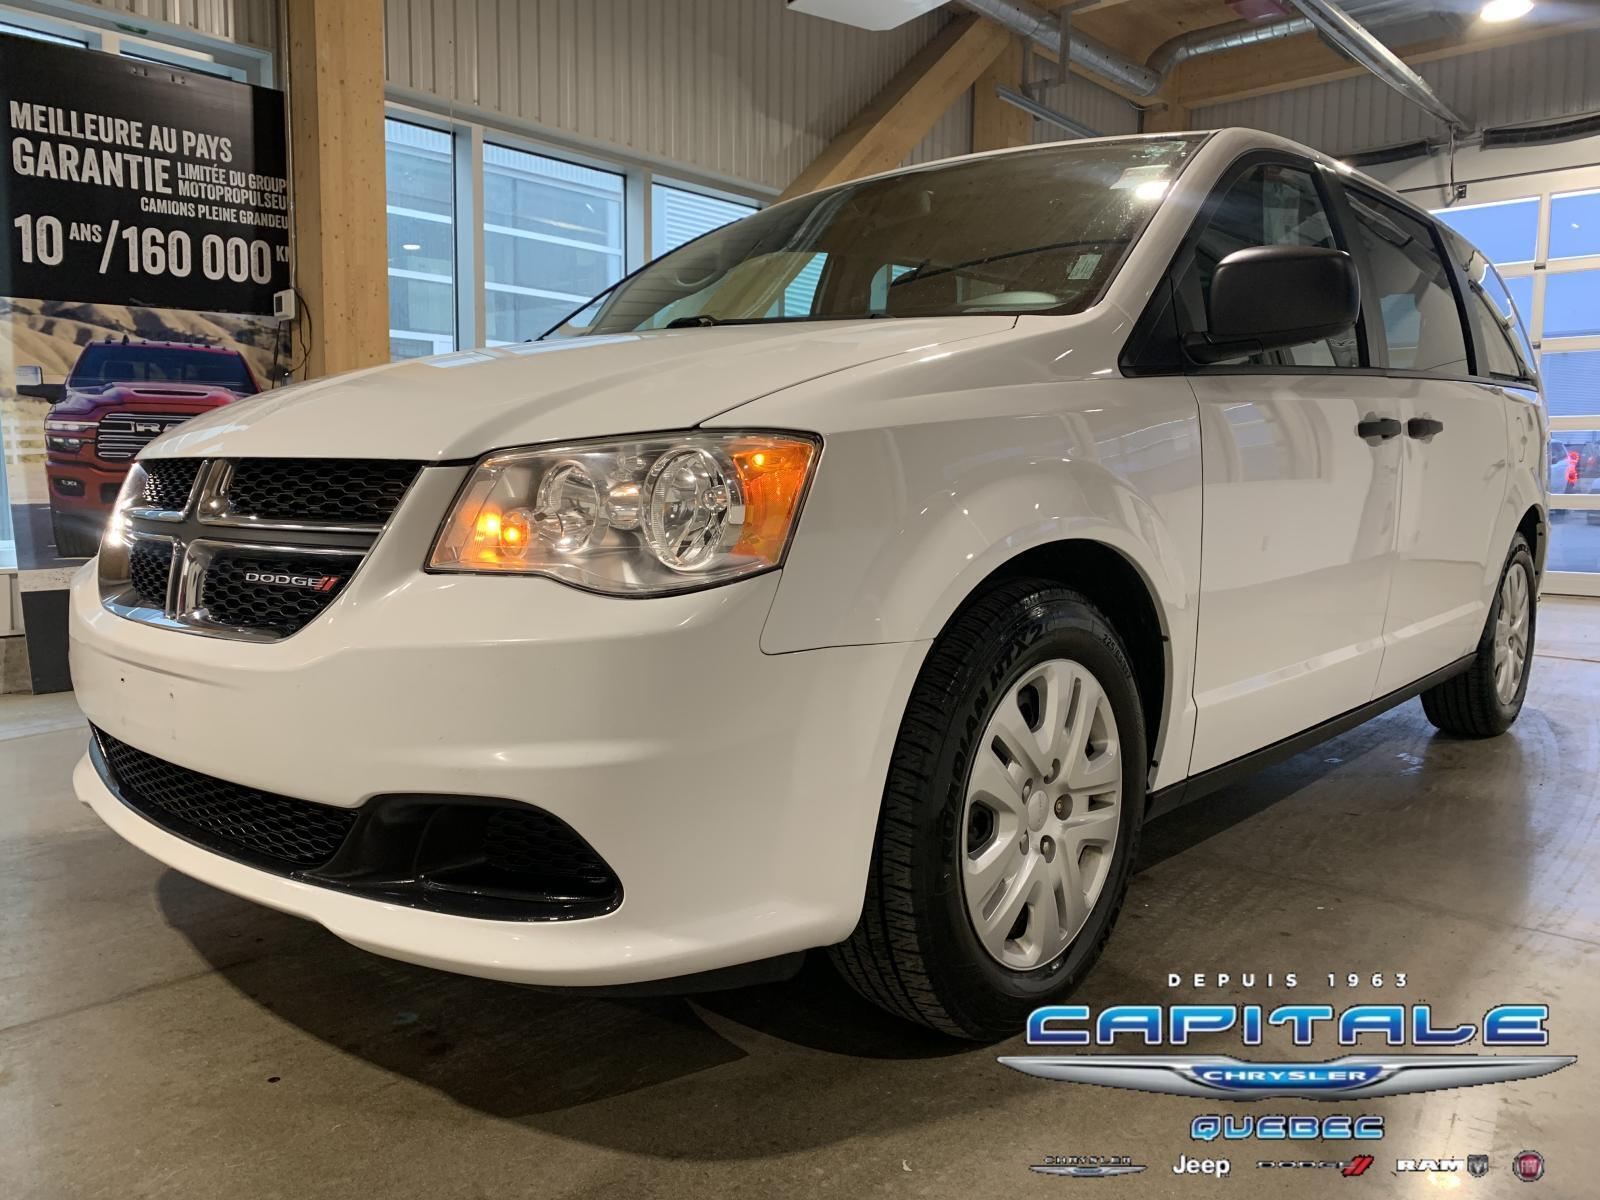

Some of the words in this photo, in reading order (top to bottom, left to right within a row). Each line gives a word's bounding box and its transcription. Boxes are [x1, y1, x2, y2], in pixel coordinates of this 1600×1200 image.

[10, 100, 144, 148] MEILLEURE
[149, 124, 177, 153] AU
[183, 129, 233, 163] PAYS
[12, 137, 172, 194] GARANTIE
[177, 161, 226, 184] LIMITÉE
[229, 170, 246, 188] DU
[248, 174, 287, 193] GROUP
[140, 196, 196, 218] CAMIONS
[198, 206, 237, 223] PLEINE
[239, 210, 288, 230] GRANDEU
[178, 180, 287, 210] MOTOPROPULSEU
[14, 213, 64, 266] 10
[202, 233, 272, 285] 000
[245, 572, 324, 588] DODGE
[990, 622, 1049, 692] HTX2
